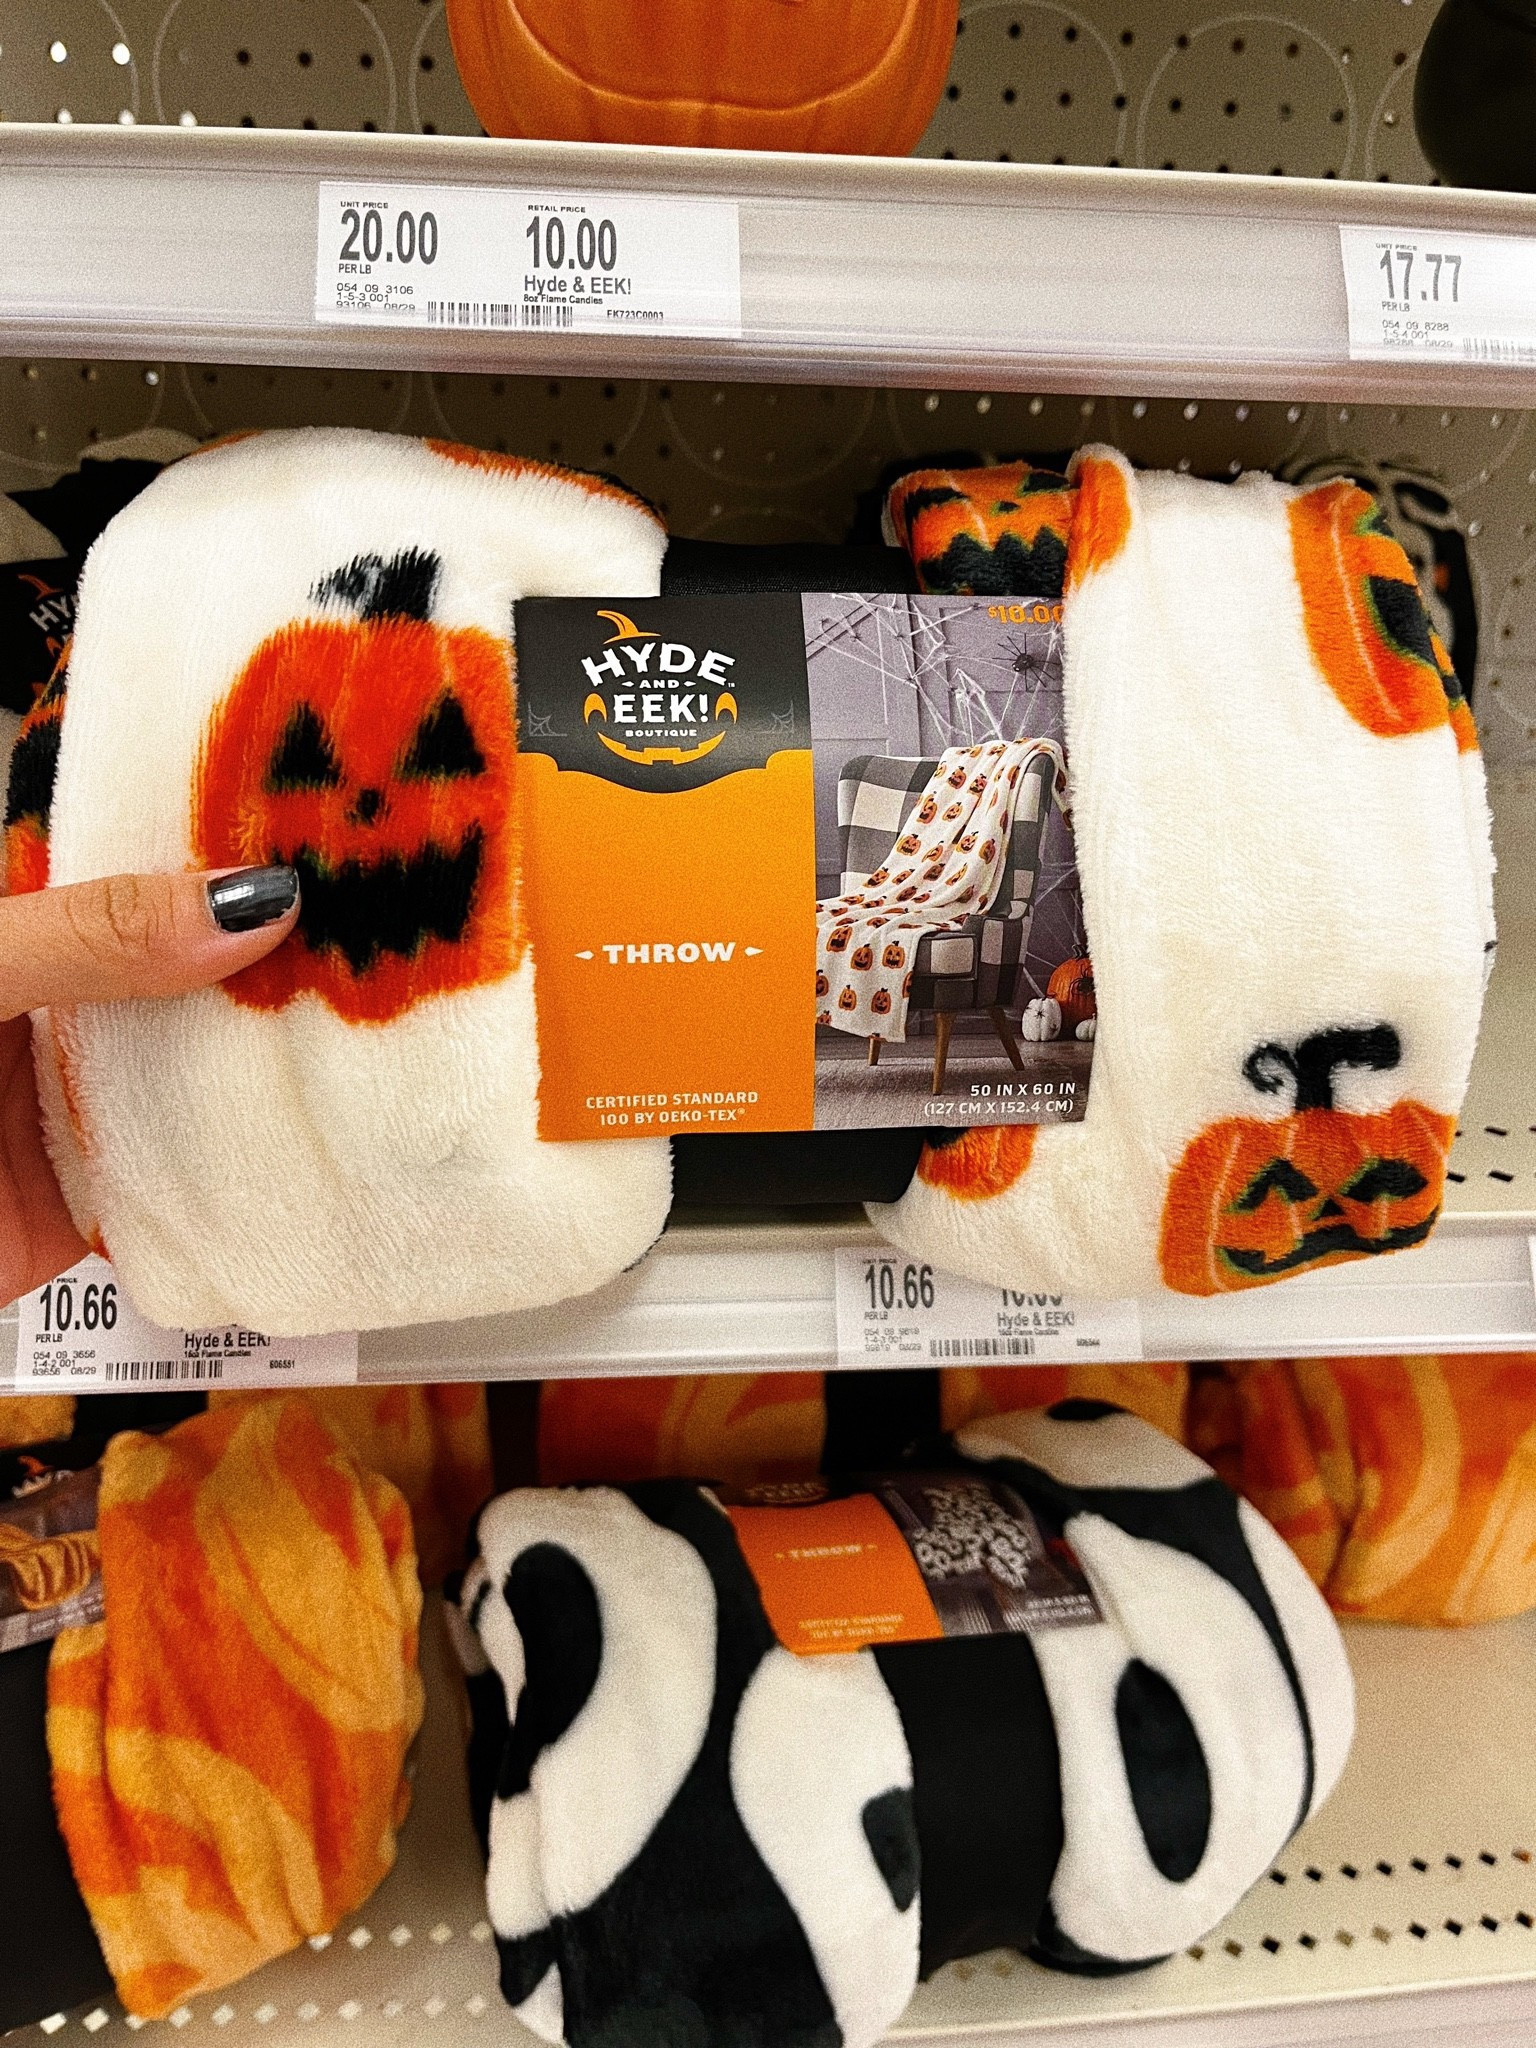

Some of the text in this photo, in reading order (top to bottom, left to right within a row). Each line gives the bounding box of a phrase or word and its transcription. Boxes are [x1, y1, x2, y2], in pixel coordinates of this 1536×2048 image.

[528, 204, 558, 213] RETAIL
[340, 208, 438, 265] 20.00
[526, 216, 617, 271] 10.00
[339, 263, 372, 274] PER LB
[1380, 250, 1462, 302] 17.77
[337, 283, 414, 295] 054 09 3106
[524, 275, 631, 296] Hyde & EEK!
[337, 292, 389, 302] 1-5-3 001
[523, 294, 603, 305] 8oz Flame Candles
[1382, 301, 1410, 312] PER LB
[1382, 320, 1400, 329] 054
[581, 642, 735, 686] HYDE
[639, 680, 680, 689] AND
[613, 694, 708, 723] EEK!
[625, 729, 697, 738] BOUTIQUE
[602, 942, 736, 964] THROW
[970, 1083, 1076, 1097] 50 IN X 60 IN
[586, 1091, 759, 1109] CERTIFIED STANDARD
[924, 1099, 1074, 1116] (127 CM X 152.4 CM)
[601, 1113, 629, 1126] 100
[634, 1112, 654, 1124] BY
[866, 1264, 934, 1309] 10.66
[40, 1283, 117, 1331] 10.66
[997, 1312, 1029, 1329] Hyde
[1033, 1312, 1042, 1326] &
[36, 1333, 63, 1343] PER LB
[185, 1333, 219, 1351] Hyde
[224, 1332, 234, 1347] &
[33, 1350, 96, 1360] 054 09 3656
[60, 1359, 76, 1368] 001
